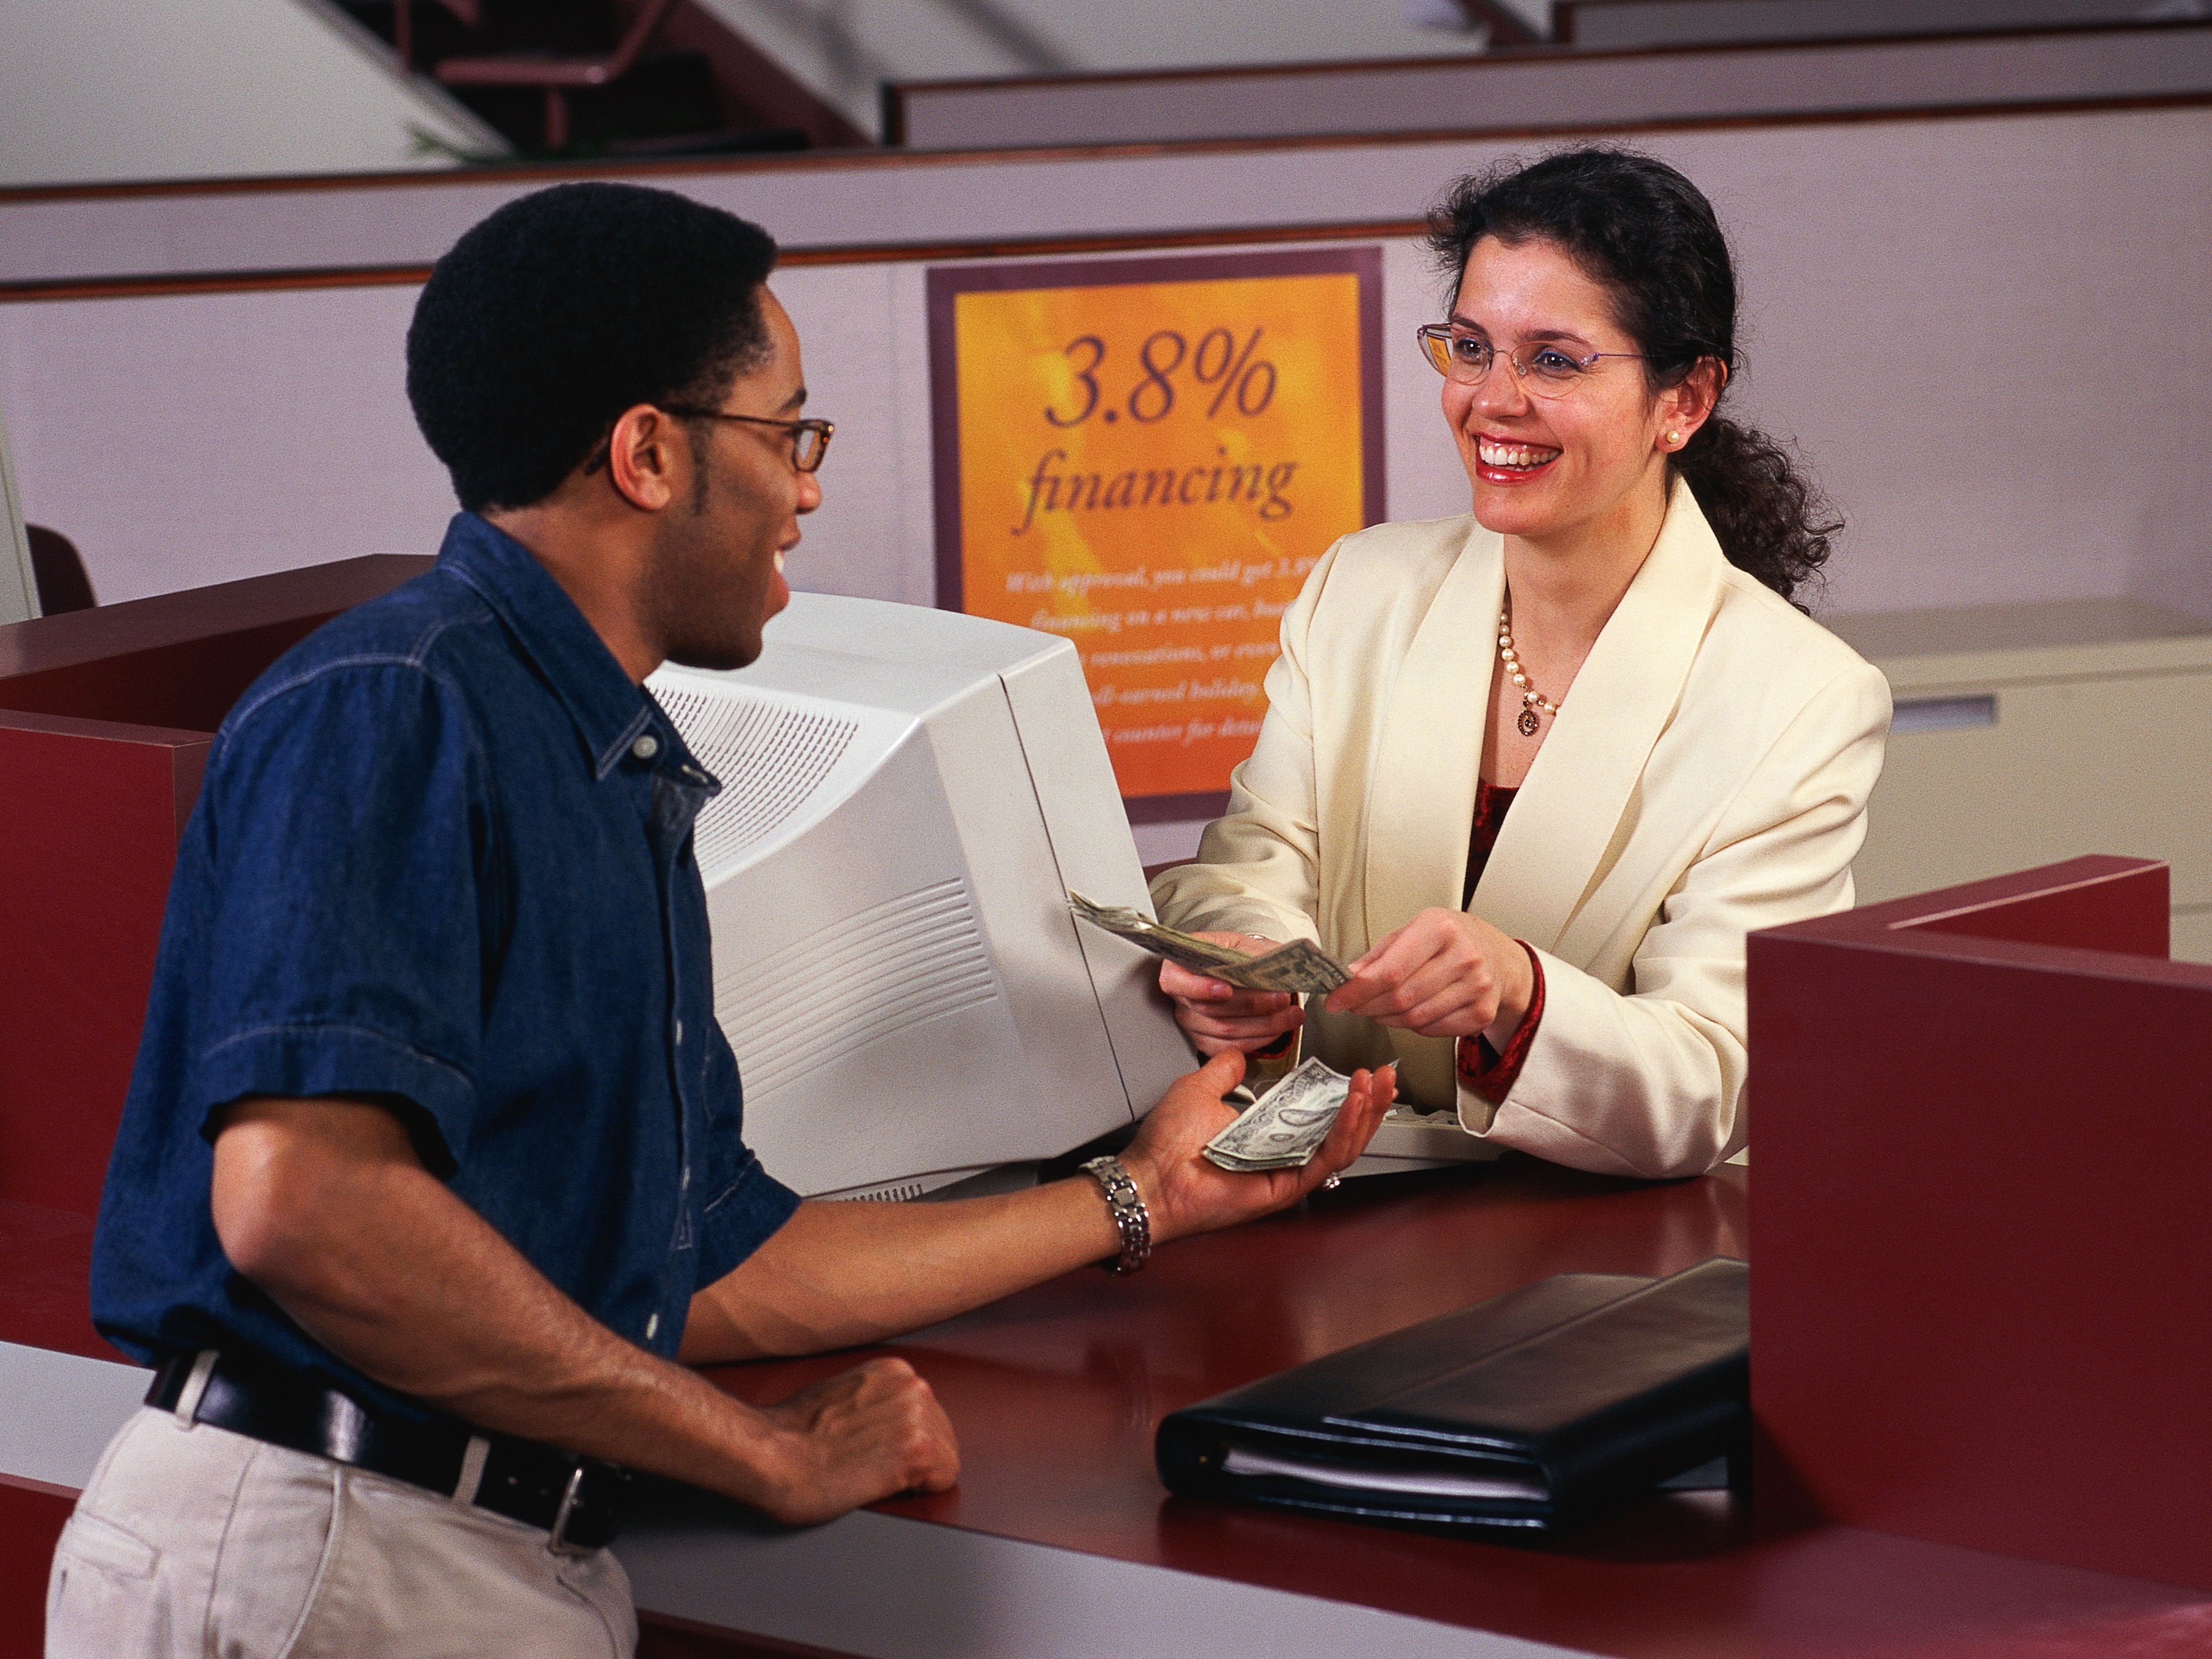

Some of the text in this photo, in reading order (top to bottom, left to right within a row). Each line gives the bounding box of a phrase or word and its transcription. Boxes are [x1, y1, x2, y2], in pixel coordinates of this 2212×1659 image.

[1045, 325, 1277, 429] 3.8%
[1011, 444, 1300, 535] financing
[1006, 571, 1054, 594] With
[1058, 565, 1149, 596] approval,
[1150, 569, 1186, 592] you
[1190, 559, 1241, 582] could
[1241, 561, 1273, 586] get
[1125, 611, 1150, 626] on
[1153, 610, 1167, 624] a
[1171, 606, 1212, 623] new
[1210, 644, 1231, 659] or
[1113, 724, 1183, 743] counter
[1182, 718, 1215, 746] for
